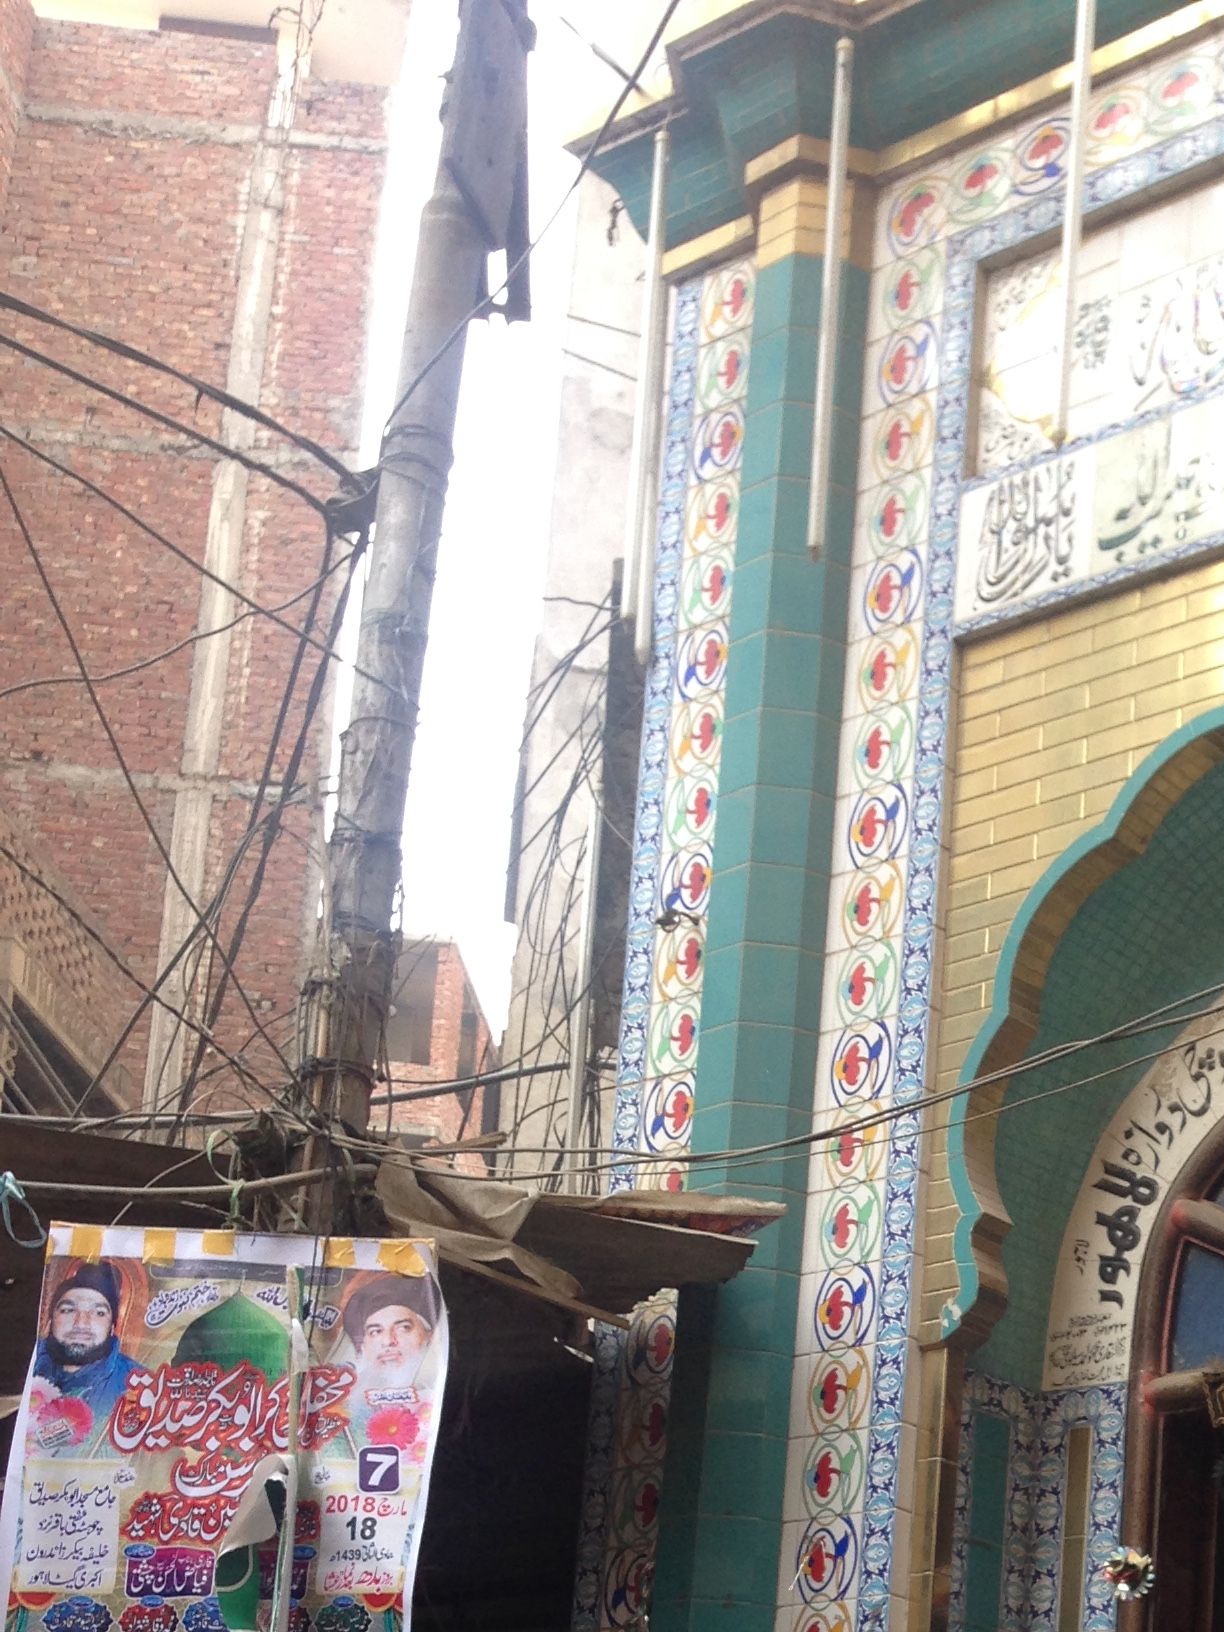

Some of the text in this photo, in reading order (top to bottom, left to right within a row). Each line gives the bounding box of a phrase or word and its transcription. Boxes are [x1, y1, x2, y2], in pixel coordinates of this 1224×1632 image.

[366, 1452, 398, 1487] 7
[159, 1499, 212, 1541] قادری
[325, 1494, 408, 1517] مارچ 2018
[345, 1516, 378, 1541] 18
